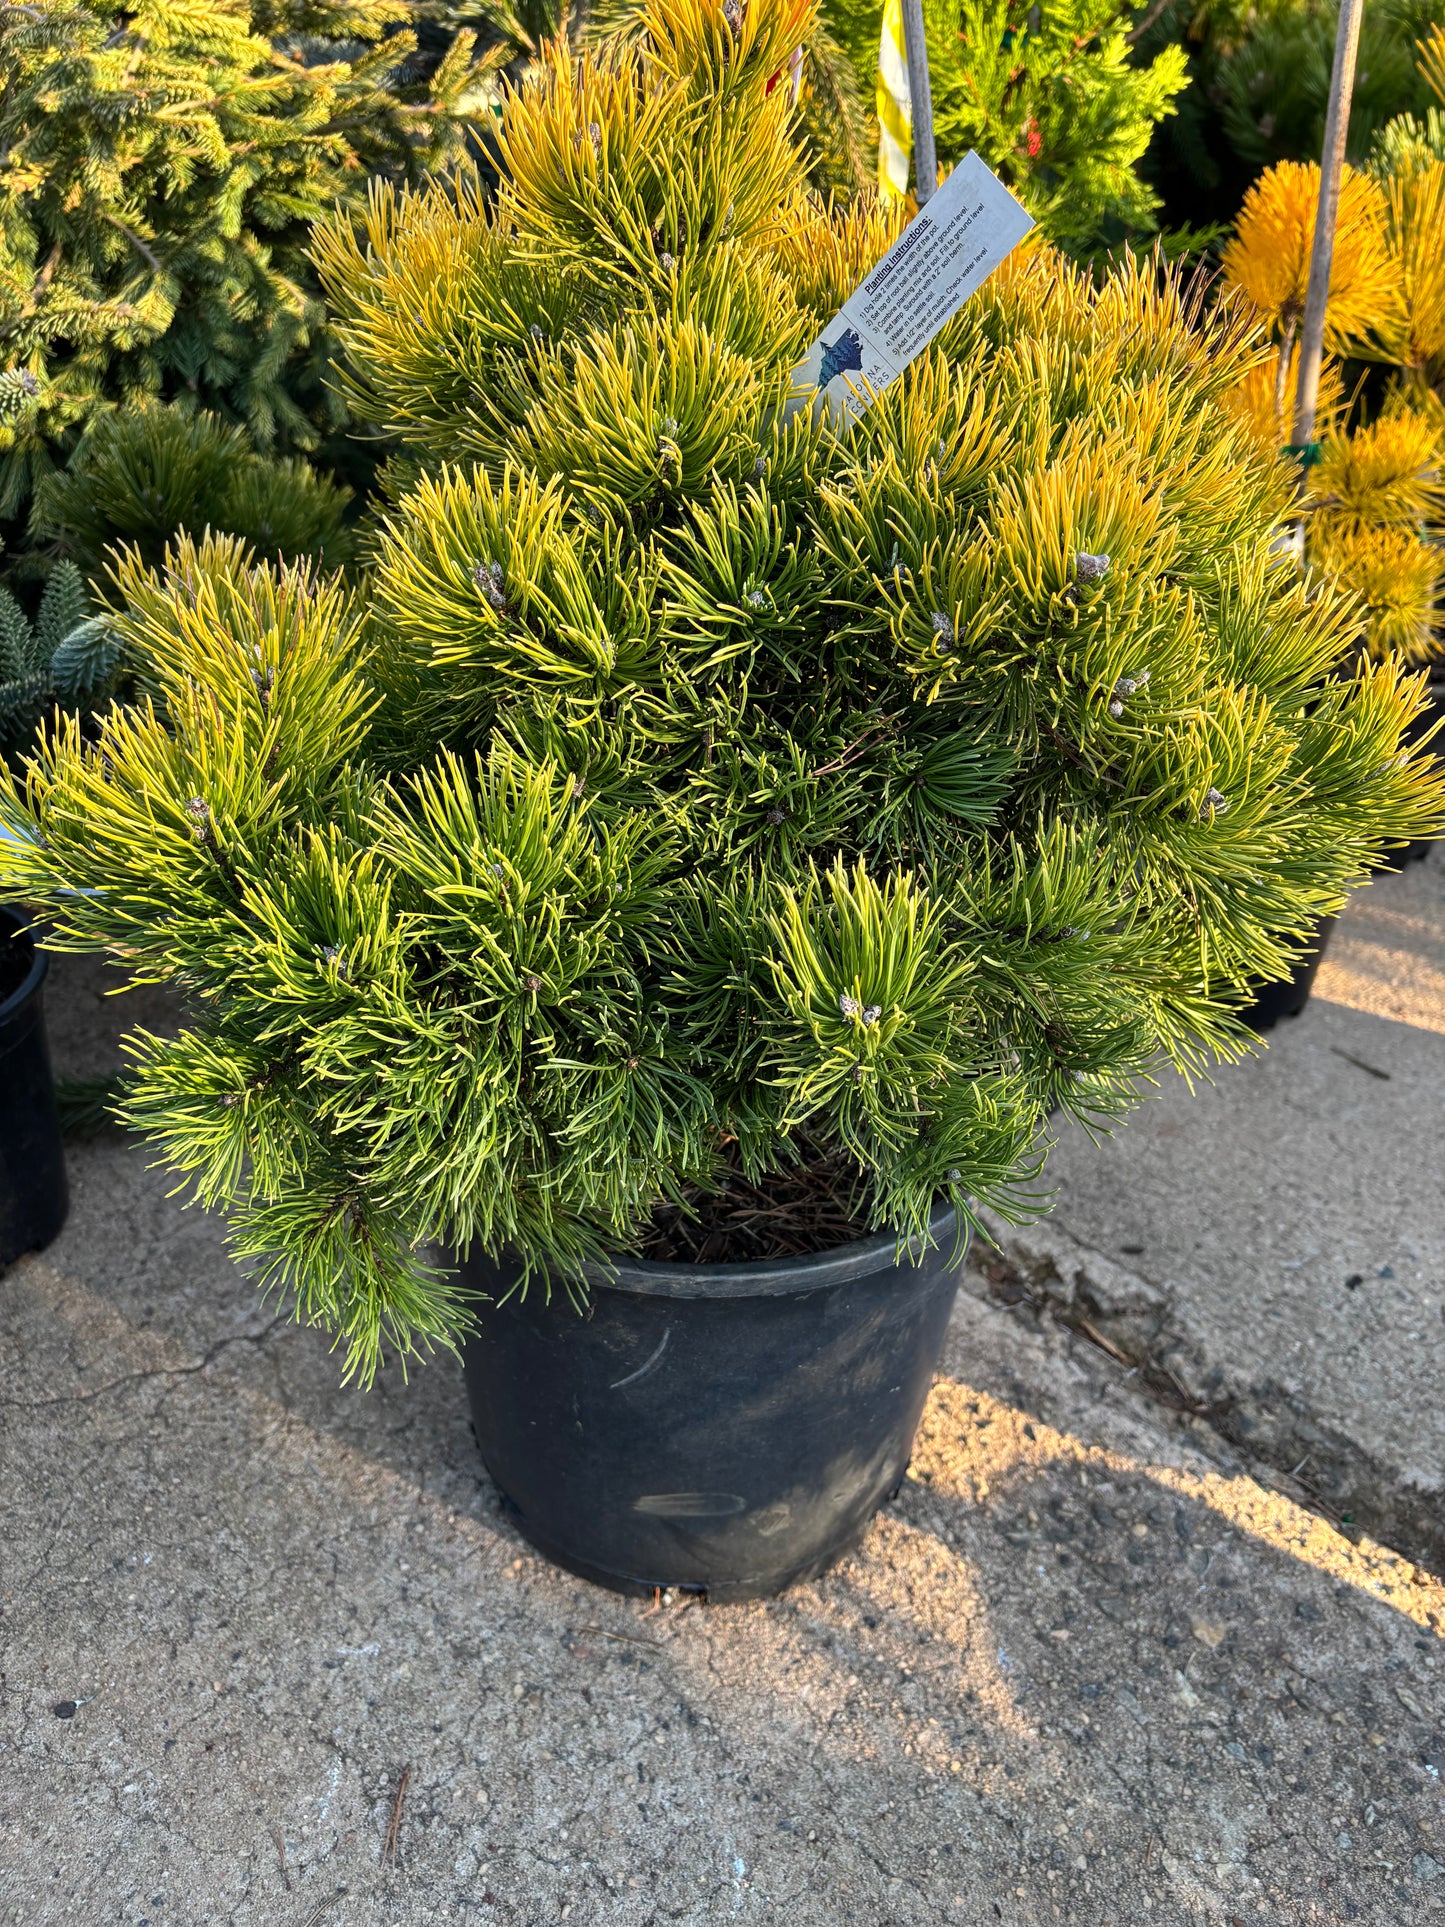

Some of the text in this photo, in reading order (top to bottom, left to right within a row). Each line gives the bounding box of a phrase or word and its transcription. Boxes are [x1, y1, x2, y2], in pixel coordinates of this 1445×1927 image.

[863, 303, 874, 314] Dig
[870, 292, 882, 305] hole
[883, 273, 898, 290] times
[895, 264, 905, 276] the
[902, 250, 917, 267] width
[919, 234, 930, 246] the
[927, 223, 940, 237] pot.
[864, 215, 932, 296] Planting Instructions:
[870, 310, 880, 321] Set
[877, 302, 888, 313] top
[889, 285, 901, 298] root
[897, 275, 909, 288] ball
[906, 257, 925, 278] slightly
[921, 240, 939, 259] above
[936, 220, 956, 243] ground
[953, 205, 969, 222] level.
[876, 305, 897, 328] Combine
[894, 285, 915, 308] planting
[911, 276, 922, 287] mix
[919, 265, 931, 278] and
[929, 254, 941, 267] soil.
[938, 244, 949, 255] Fill
[952, 217, 973, 241] ground
[969, 202, 985, 219] level
[882, 323, 893, 335] and
[902, 288, 923, 312] Suround
[920, 277, 932, 291] with
[939, 256, 951, 268] soil
[889, 325, 905, 341] Water
[911, 300, 926, 316] settle
[896, 337, 908, 349] Add
[905, 327, 916, 339] 1/2"
[914, 315, 928, 330] layer
[944, 276, 962, 295] Check
[959, 261, 976, 278] water
[973, 247, 988, 263] level
[902, 331, 926, 357] frequently
[922, 320, 935, 333] until
[850, 371, 889, 414] CONIERS
